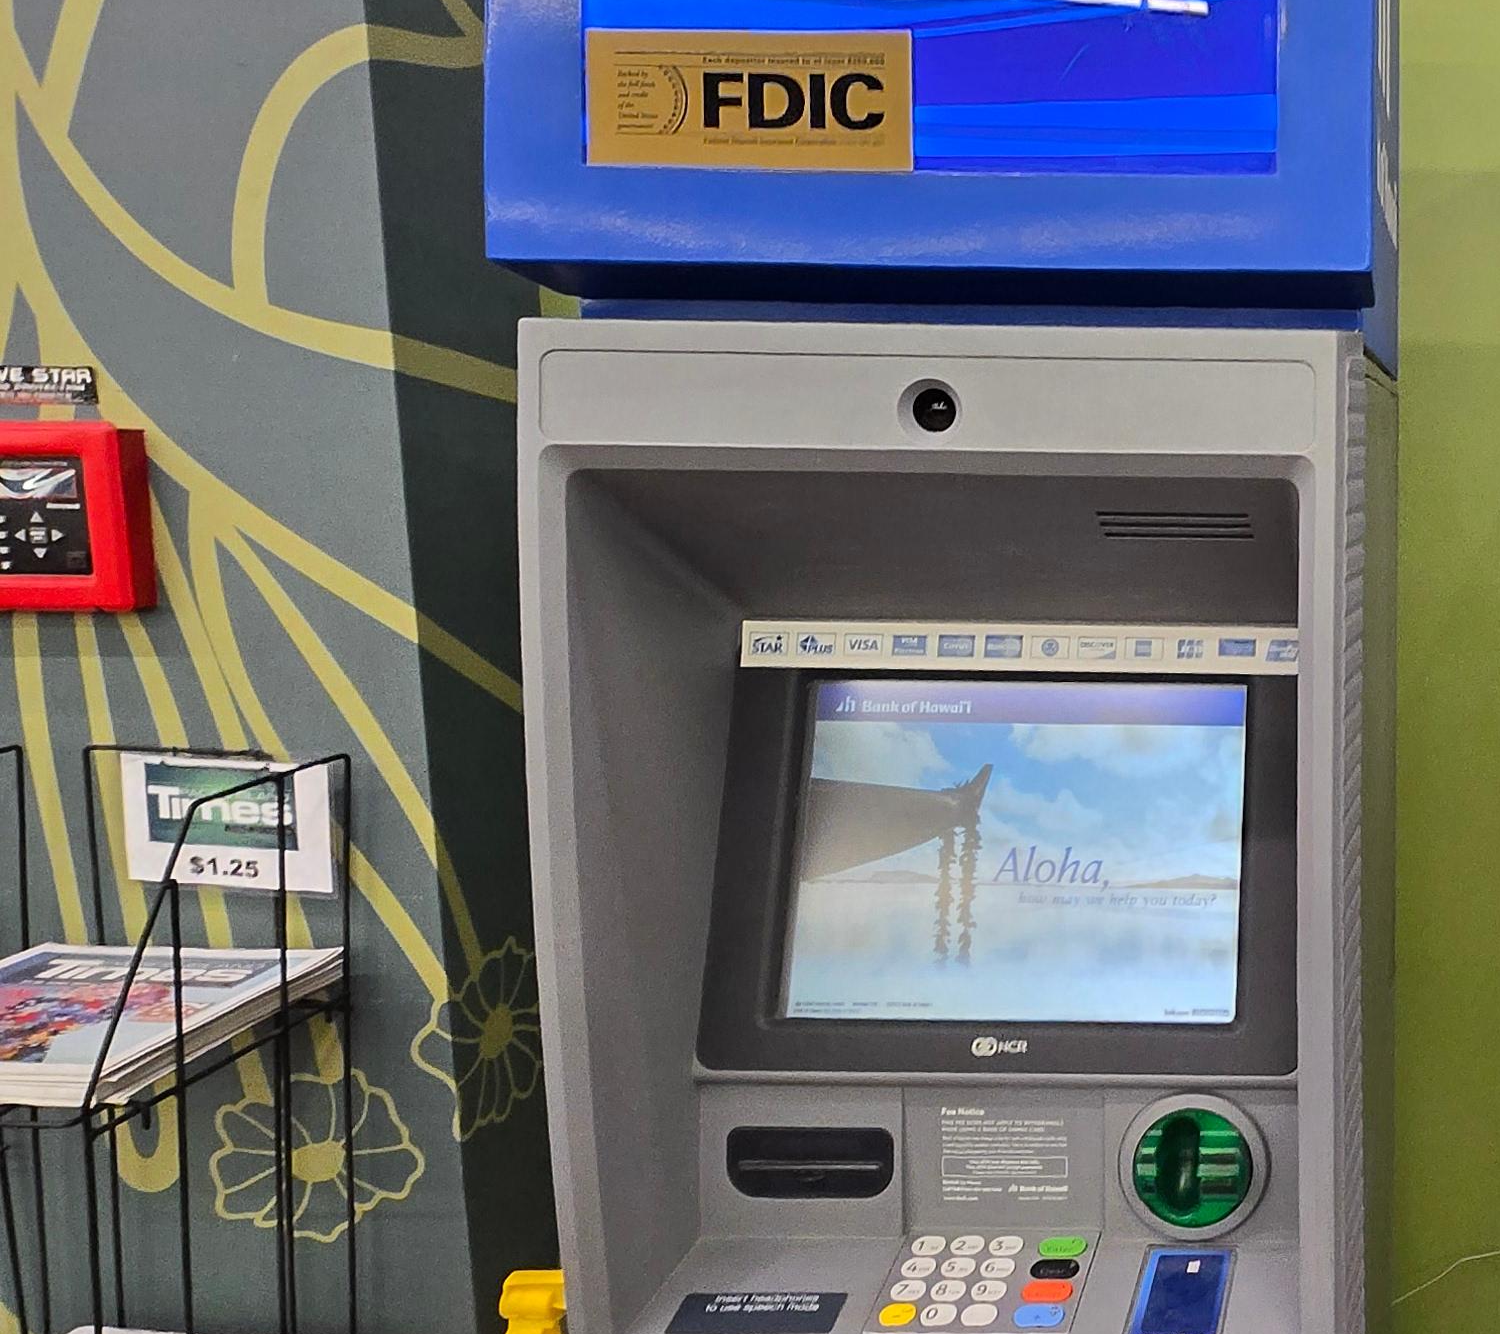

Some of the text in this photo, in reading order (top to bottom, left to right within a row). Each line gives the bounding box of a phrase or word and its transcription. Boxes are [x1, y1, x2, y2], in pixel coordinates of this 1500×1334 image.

[703, 71, 885, 131] FDIC
[31, 367, 93, 384] STAR
[751, 636, 784, 654] STAR
[848, 638, 880, 652] VISA
[862, 700, 900, 714] Bank
[901, 700, 918, 714] of
[190, 855, 260, 879] $1.25
[993, 845, 1111, 892] Aloha,
[1109, 892, 1138, 908] help
[1142, 895, 1167, 908] you
[1172, 892, 1218, 908] today?
